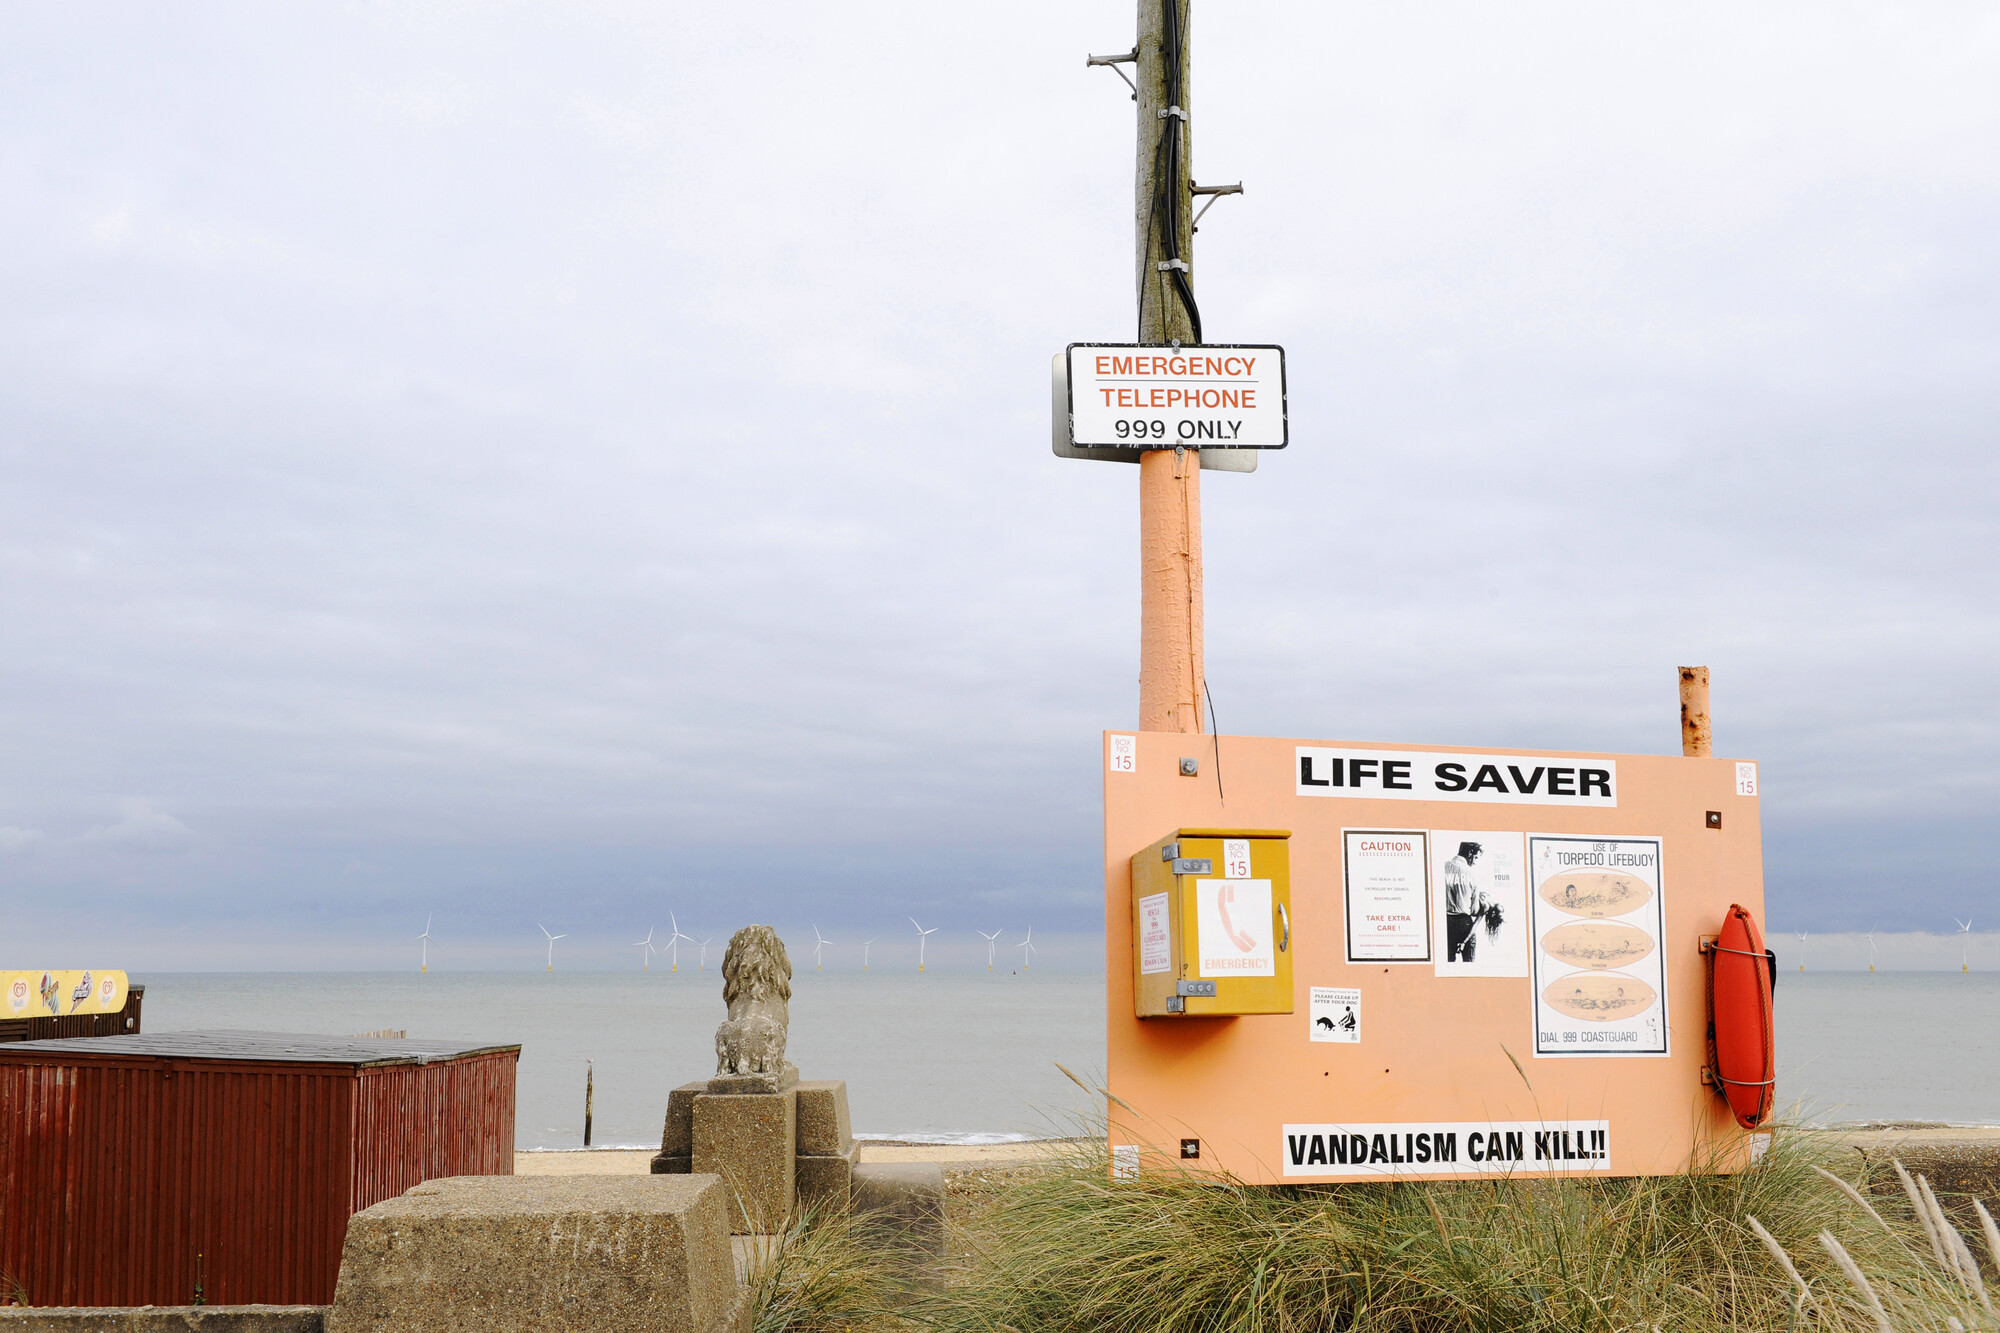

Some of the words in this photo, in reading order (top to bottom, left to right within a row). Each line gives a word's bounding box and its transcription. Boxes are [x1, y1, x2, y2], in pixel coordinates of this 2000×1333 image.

[1095, 356, 1256, 376] EMERGENCY
[1099, 388, 1257, 408] TELEPHONE
[1114, 420, 1166, 439] 999
[1177, 420, 1242, 439] ONLY
[1115, 738, 1131, 746] BOX
[1115, 755, 1132, 770] 15
[1300, 756, 1413, 790] LIFE
[1434, 762, 1613, 798] SAVER
[1740, 781, 1754, 794] 15
[1228, 843, 1245, 851] BOX
[1360, 841, 1411, 852] CAUTION
[1592, 843, 1606, 852] USE
[1610, 843, 1618, 852] OF
[1556, 852, 1604, 866] TORPEDO
[1608, 853, 1655, 867] LIFEBUOY
[1229, 861, 1247, 876] 15
[1204, 957, 1269, 970] EMERGENCY
[1540, 1032, 1559, 1043] DIAL
[1562, 1031, 1578, 1043] 999
[1581, 1031, 1638, 1043] COASTGUARD
[1287, 1132, 1458, 1166] VANDALISM
[1467, 1131, 1525, 1162] CAN
[1534, 1129, 1606, 1161] KILL!!
